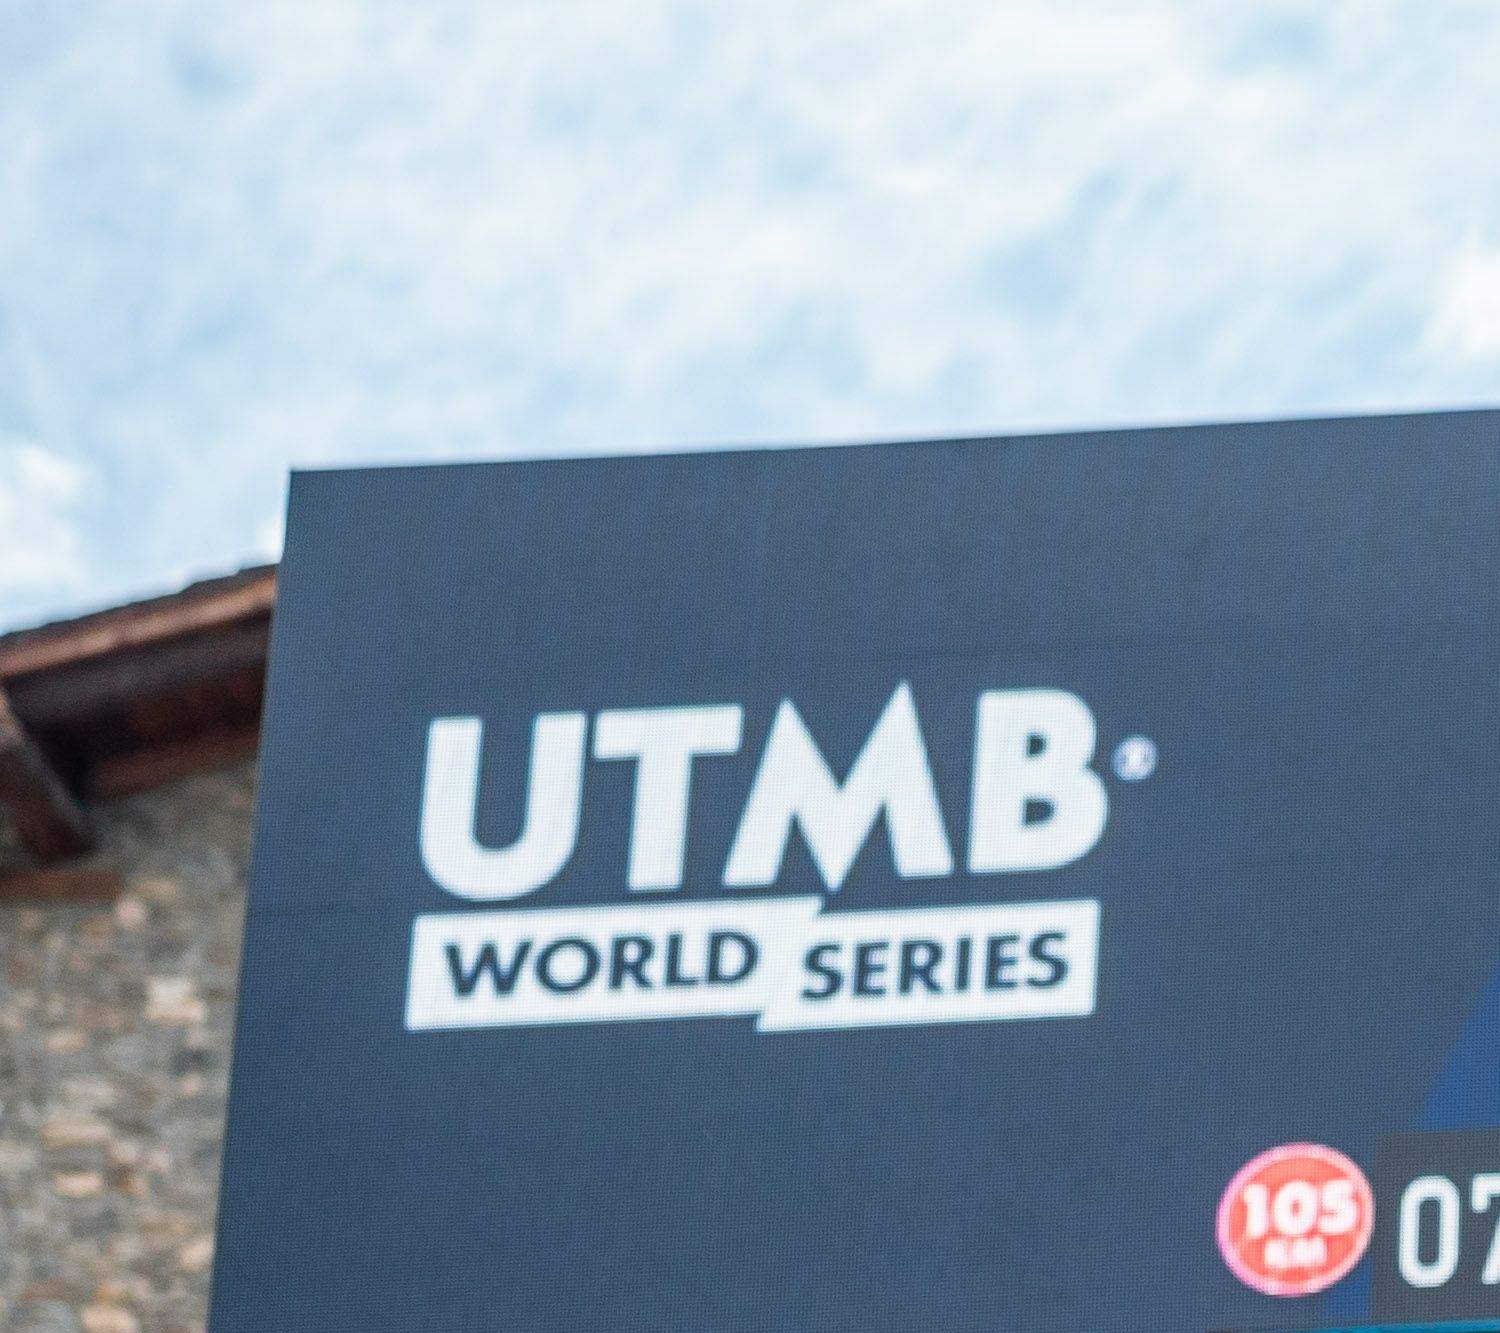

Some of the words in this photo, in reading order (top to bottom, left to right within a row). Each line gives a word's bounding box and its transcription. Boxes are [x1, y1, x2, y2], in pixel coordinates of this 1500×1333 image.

[419, 678, 1110, 901] UTMB
[444, 930, 758, 998] WORLD
[801, 929, 1070, 1001] SERIES
[1243, 1178, 1358, 1239] 105
